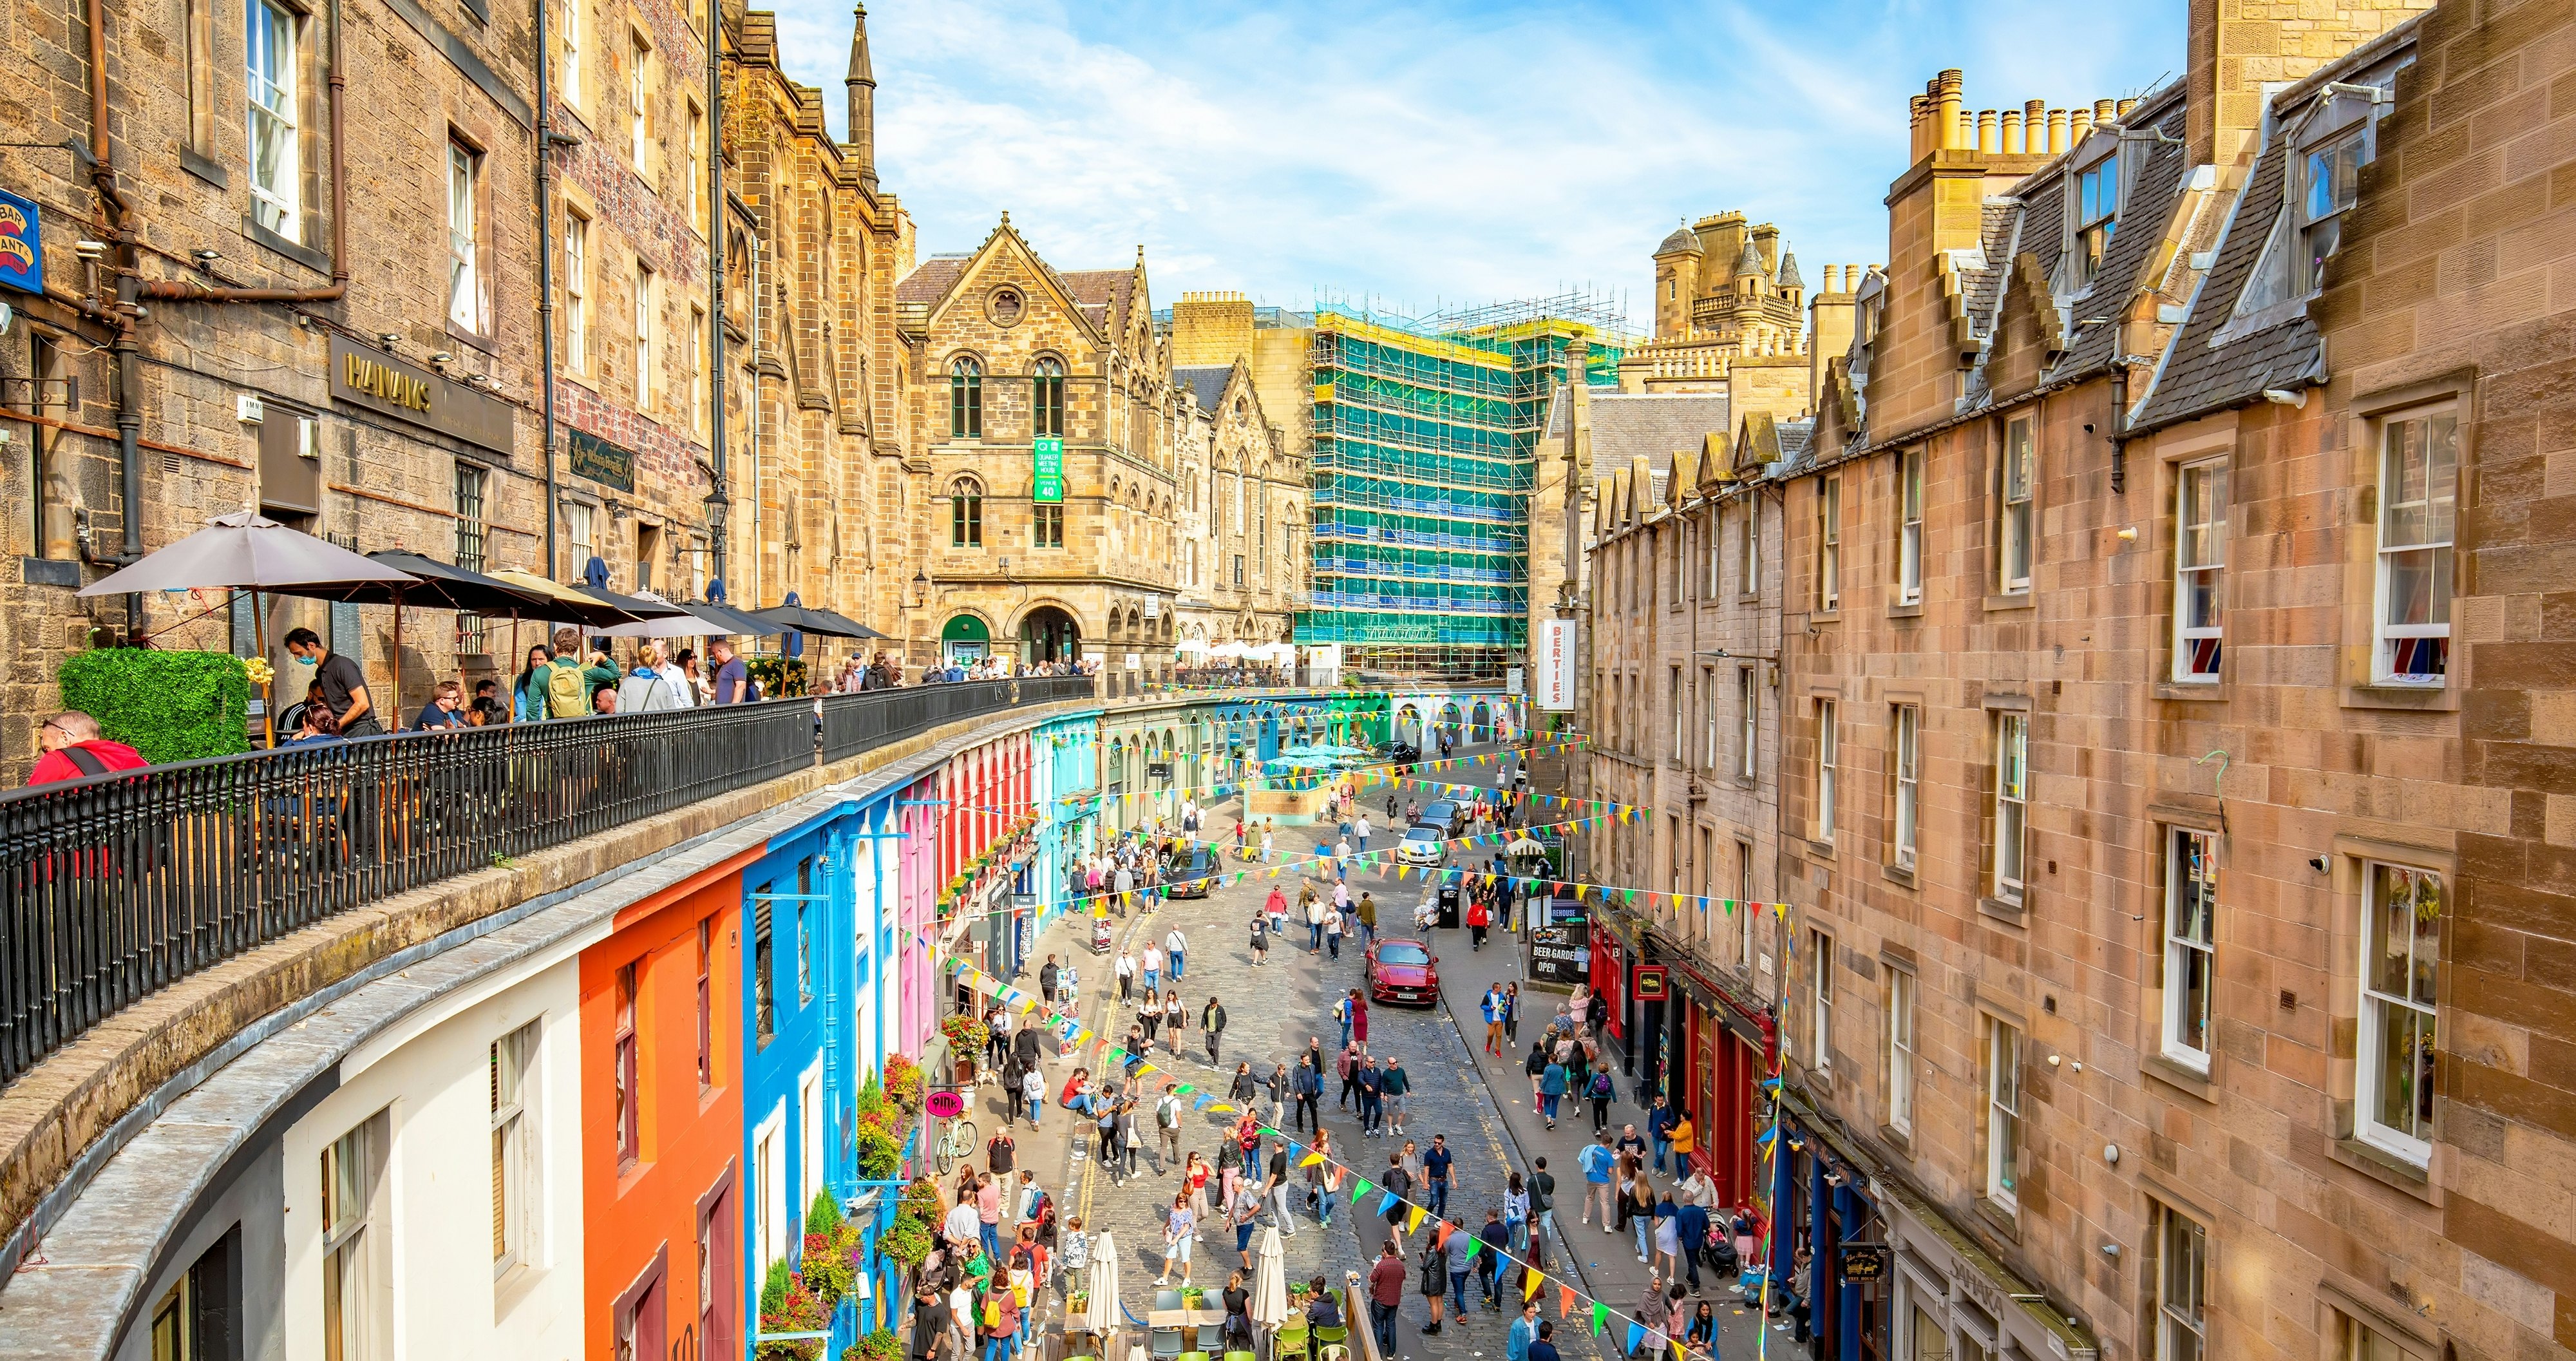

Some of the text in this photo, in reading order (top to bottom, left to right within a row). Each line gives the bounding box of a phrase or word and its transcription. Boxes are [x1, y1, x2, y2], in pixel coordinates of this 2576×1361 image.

[0, 207, 21, 226] BAR
[1, 238, 23, 253] ANT
[344, 352, 431, 413] HANAMS
[1042, 486, 1054, 497] 40
[1553, 626, 1561, 703] BERTIES
[1533, 946, 1575, 961] BEER GARDE
[1538, 962, 1556, 973] OPEN
[1951, 1257, 2004, 1321] SAHARA
